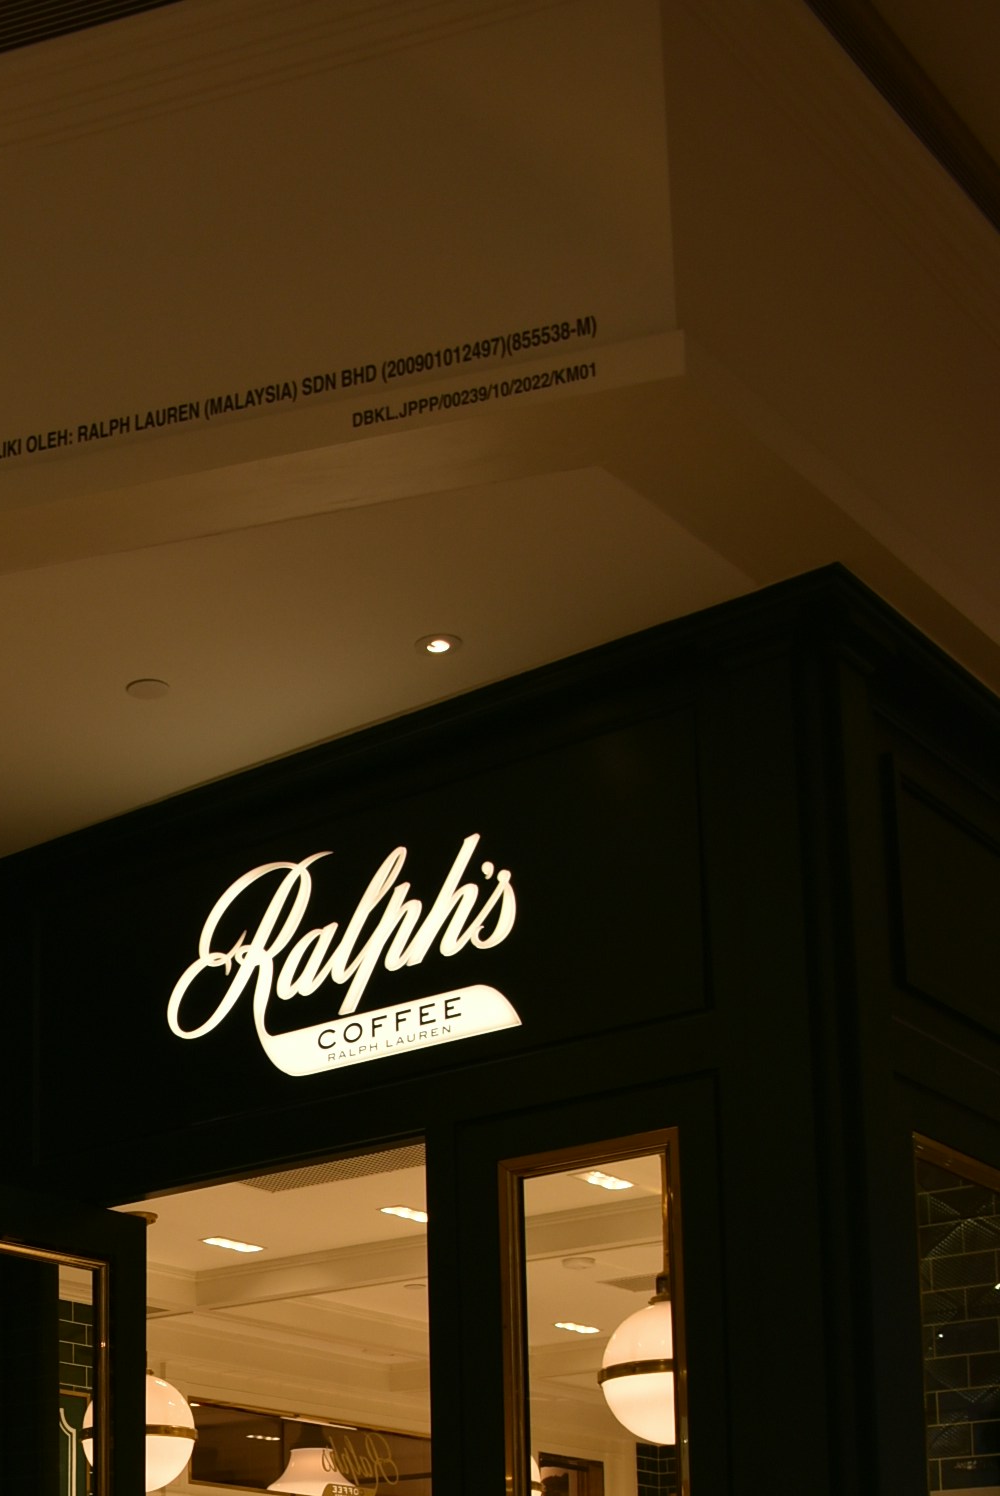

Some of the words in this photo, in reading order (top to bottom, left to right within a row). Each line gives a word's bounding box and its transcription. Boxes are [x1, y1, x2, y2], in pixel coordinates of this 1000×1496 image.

[26, 429, 74, 454] OLEH:
[77, 416, 130, 442] RALPH
[134, 401, 200, 431] LAUREN
[204, 380, 297, 420] (MALAYSIA)
[301, 372, 336, 396] SDN
[341, 364, 377, 388] BHD
[167, 833, 517, 1040] Ralph's
[317, 996, 462, 1049] COFFEE
[327, 1042, 378, 1062] RALPH
[386, 1025, 452, 1048] LAUREN
